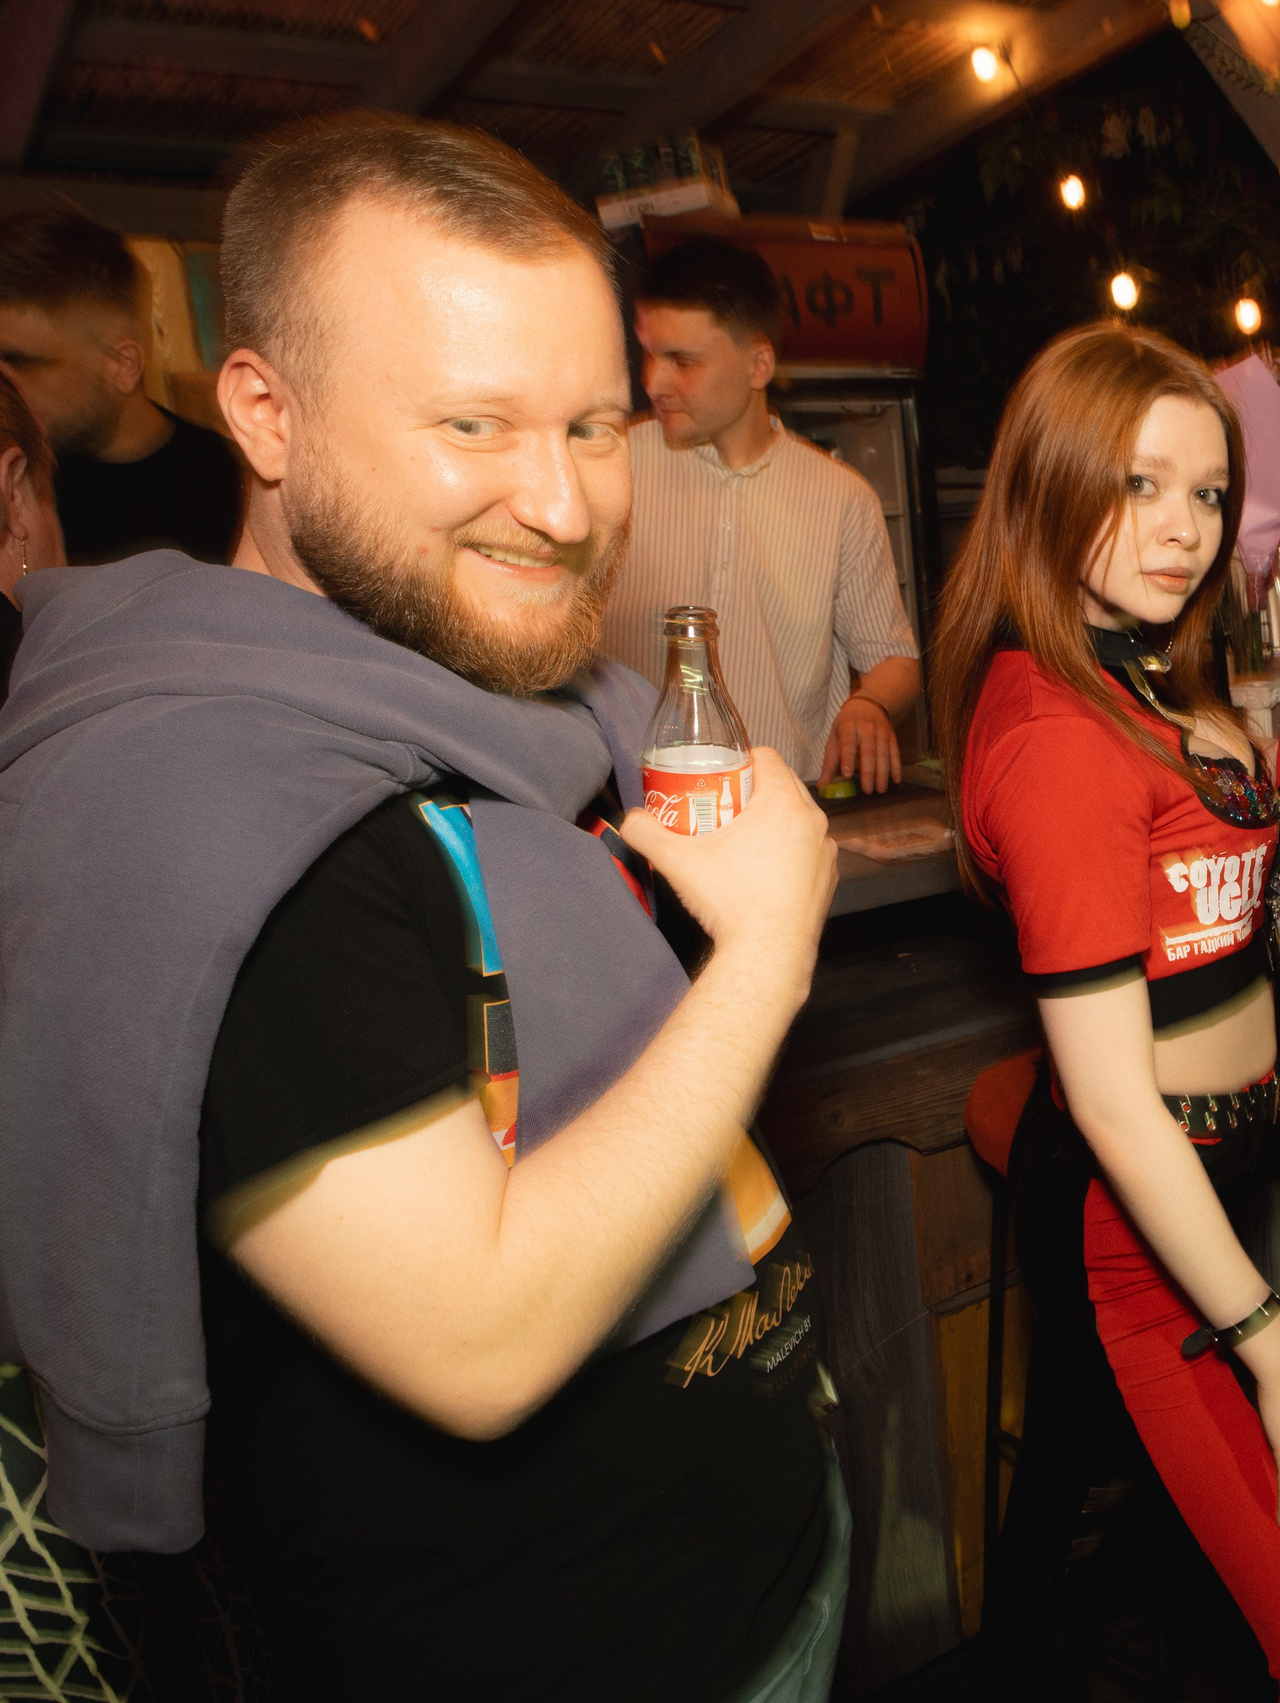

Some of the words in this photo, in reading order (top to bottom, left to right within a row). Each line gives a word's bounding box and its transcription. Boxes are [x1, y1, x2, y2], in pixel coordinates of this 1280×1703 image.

[644, 789, 684, 827] Cola
[1165, 843, 1268, 893] COYOTE
[1167, 944, 1191, 962] БАР
[1194, 930, 1235, 955] ГАДКИЙ
[766, 1324, 805, 1373] MALEVICH
[803, 1315, 812, 1332] BY
